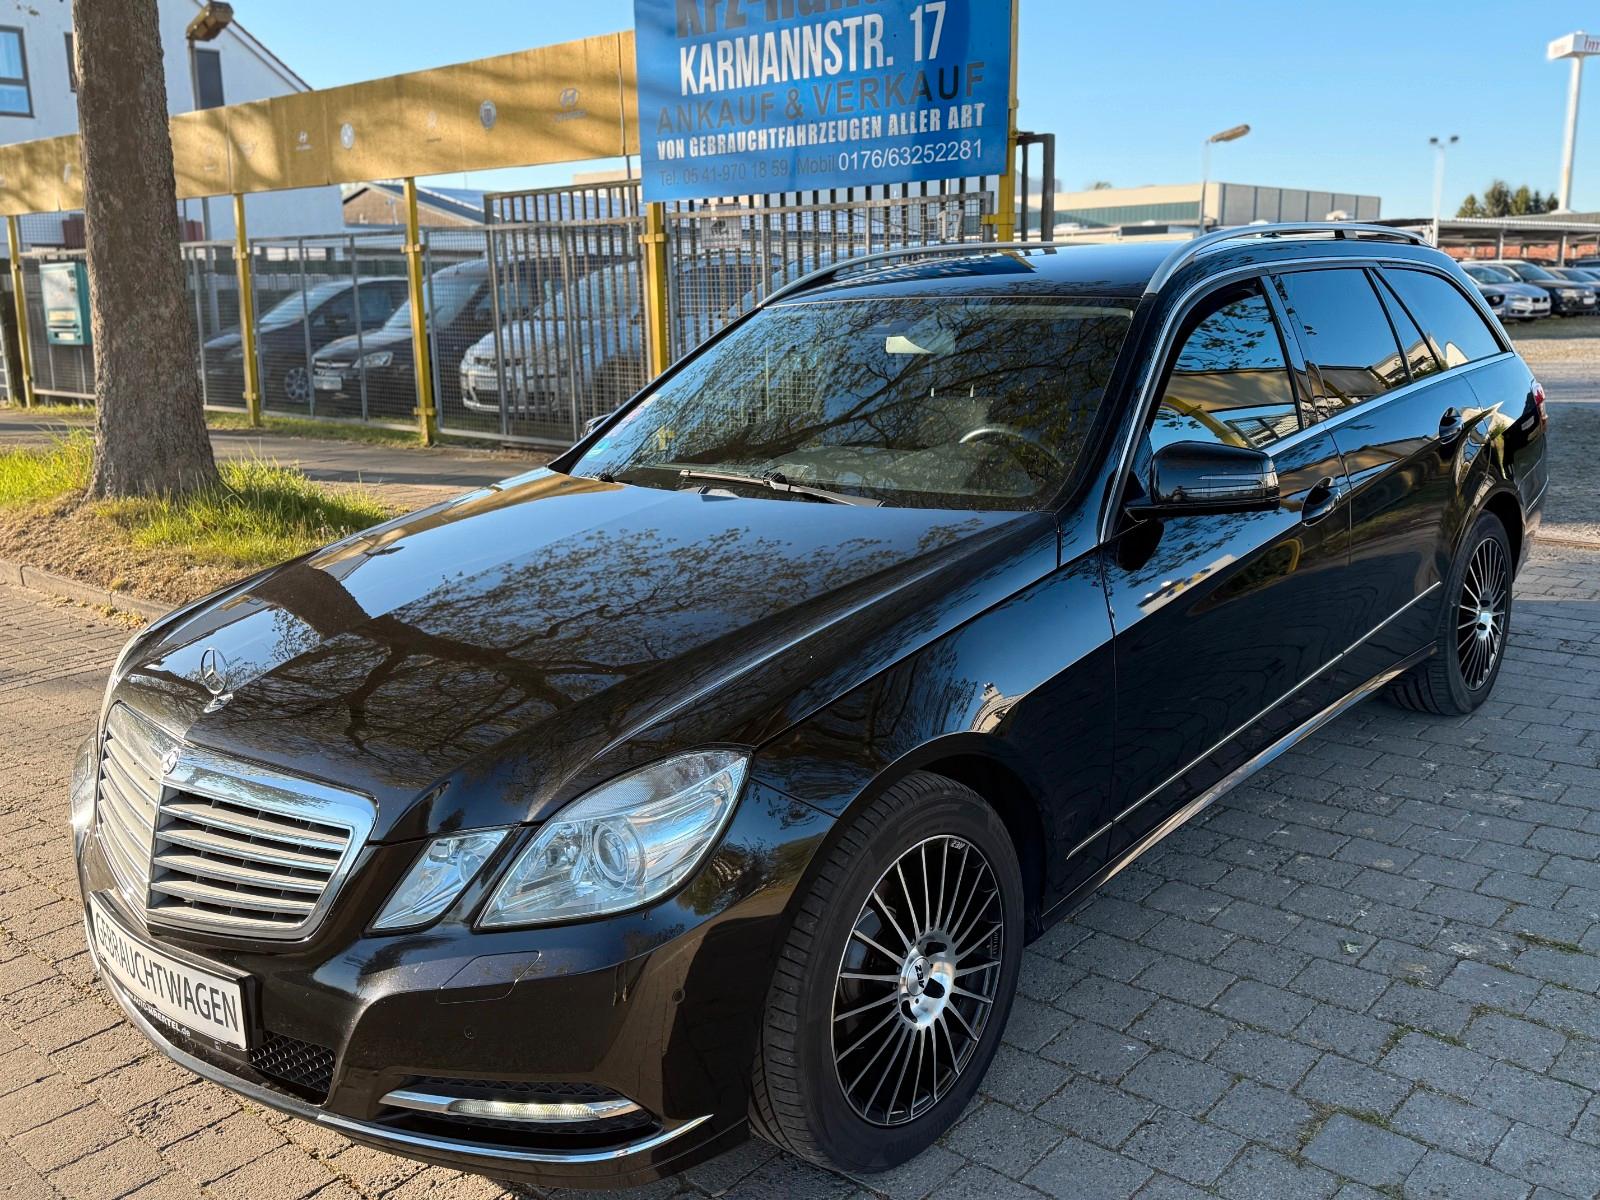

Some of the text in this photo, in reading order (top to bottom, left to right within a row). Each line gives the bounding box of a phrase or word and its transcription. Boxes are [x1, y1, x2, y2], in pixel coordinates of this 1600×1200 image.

[680, 1, 946, 96] KARMANNSTR. 17
[657, 62, 985, 134] ANKAUF & VERKAUF
[657, 103, 985, 160] VON GEBRAUCHTFAHRZEUGEN ALLER ART
[660, 170, 679, 186] Tel.
[702, 163, 746, 182] 41-970
[752, 161, 766, 178] 18
[838, 138, 981, 171] 0176/63252281
[96, 912, 238, 1032] GEBRAUCHTWAGEN
